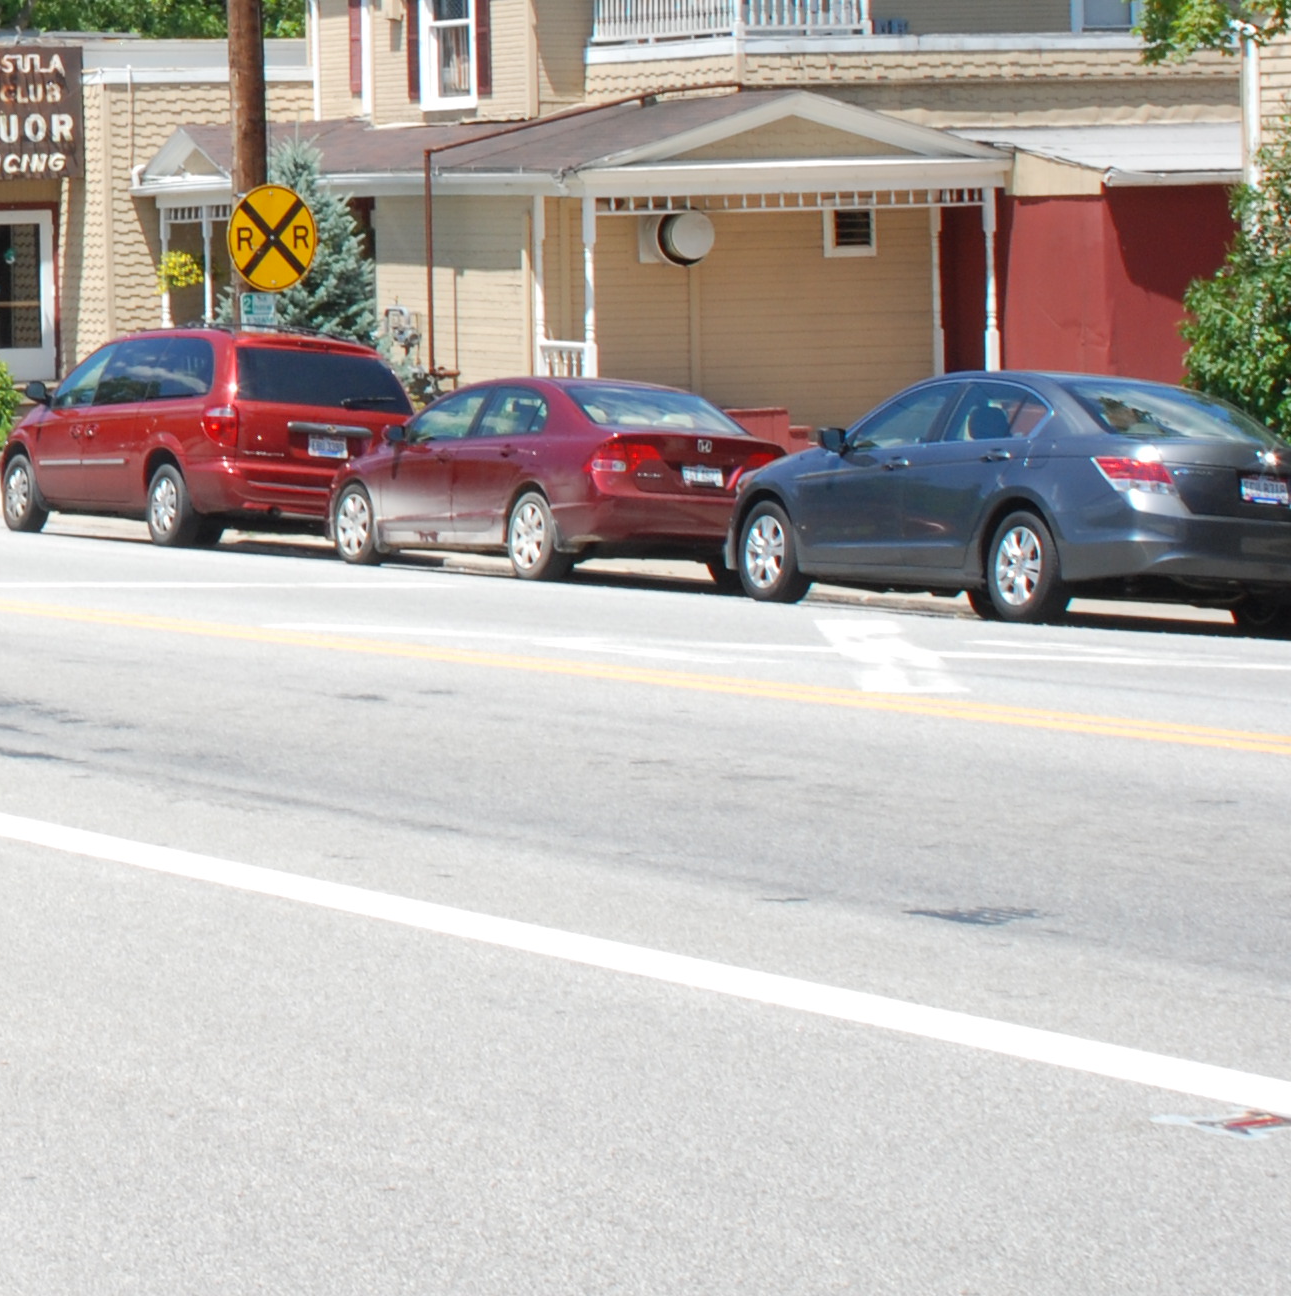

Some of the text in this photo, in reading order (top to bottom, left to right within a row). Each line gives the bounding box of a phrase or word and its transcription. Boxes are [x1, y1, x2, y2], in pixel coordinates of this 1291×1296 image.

[0, 82, 62, 104] CLUB
[236, 225, 309, 251] R R
